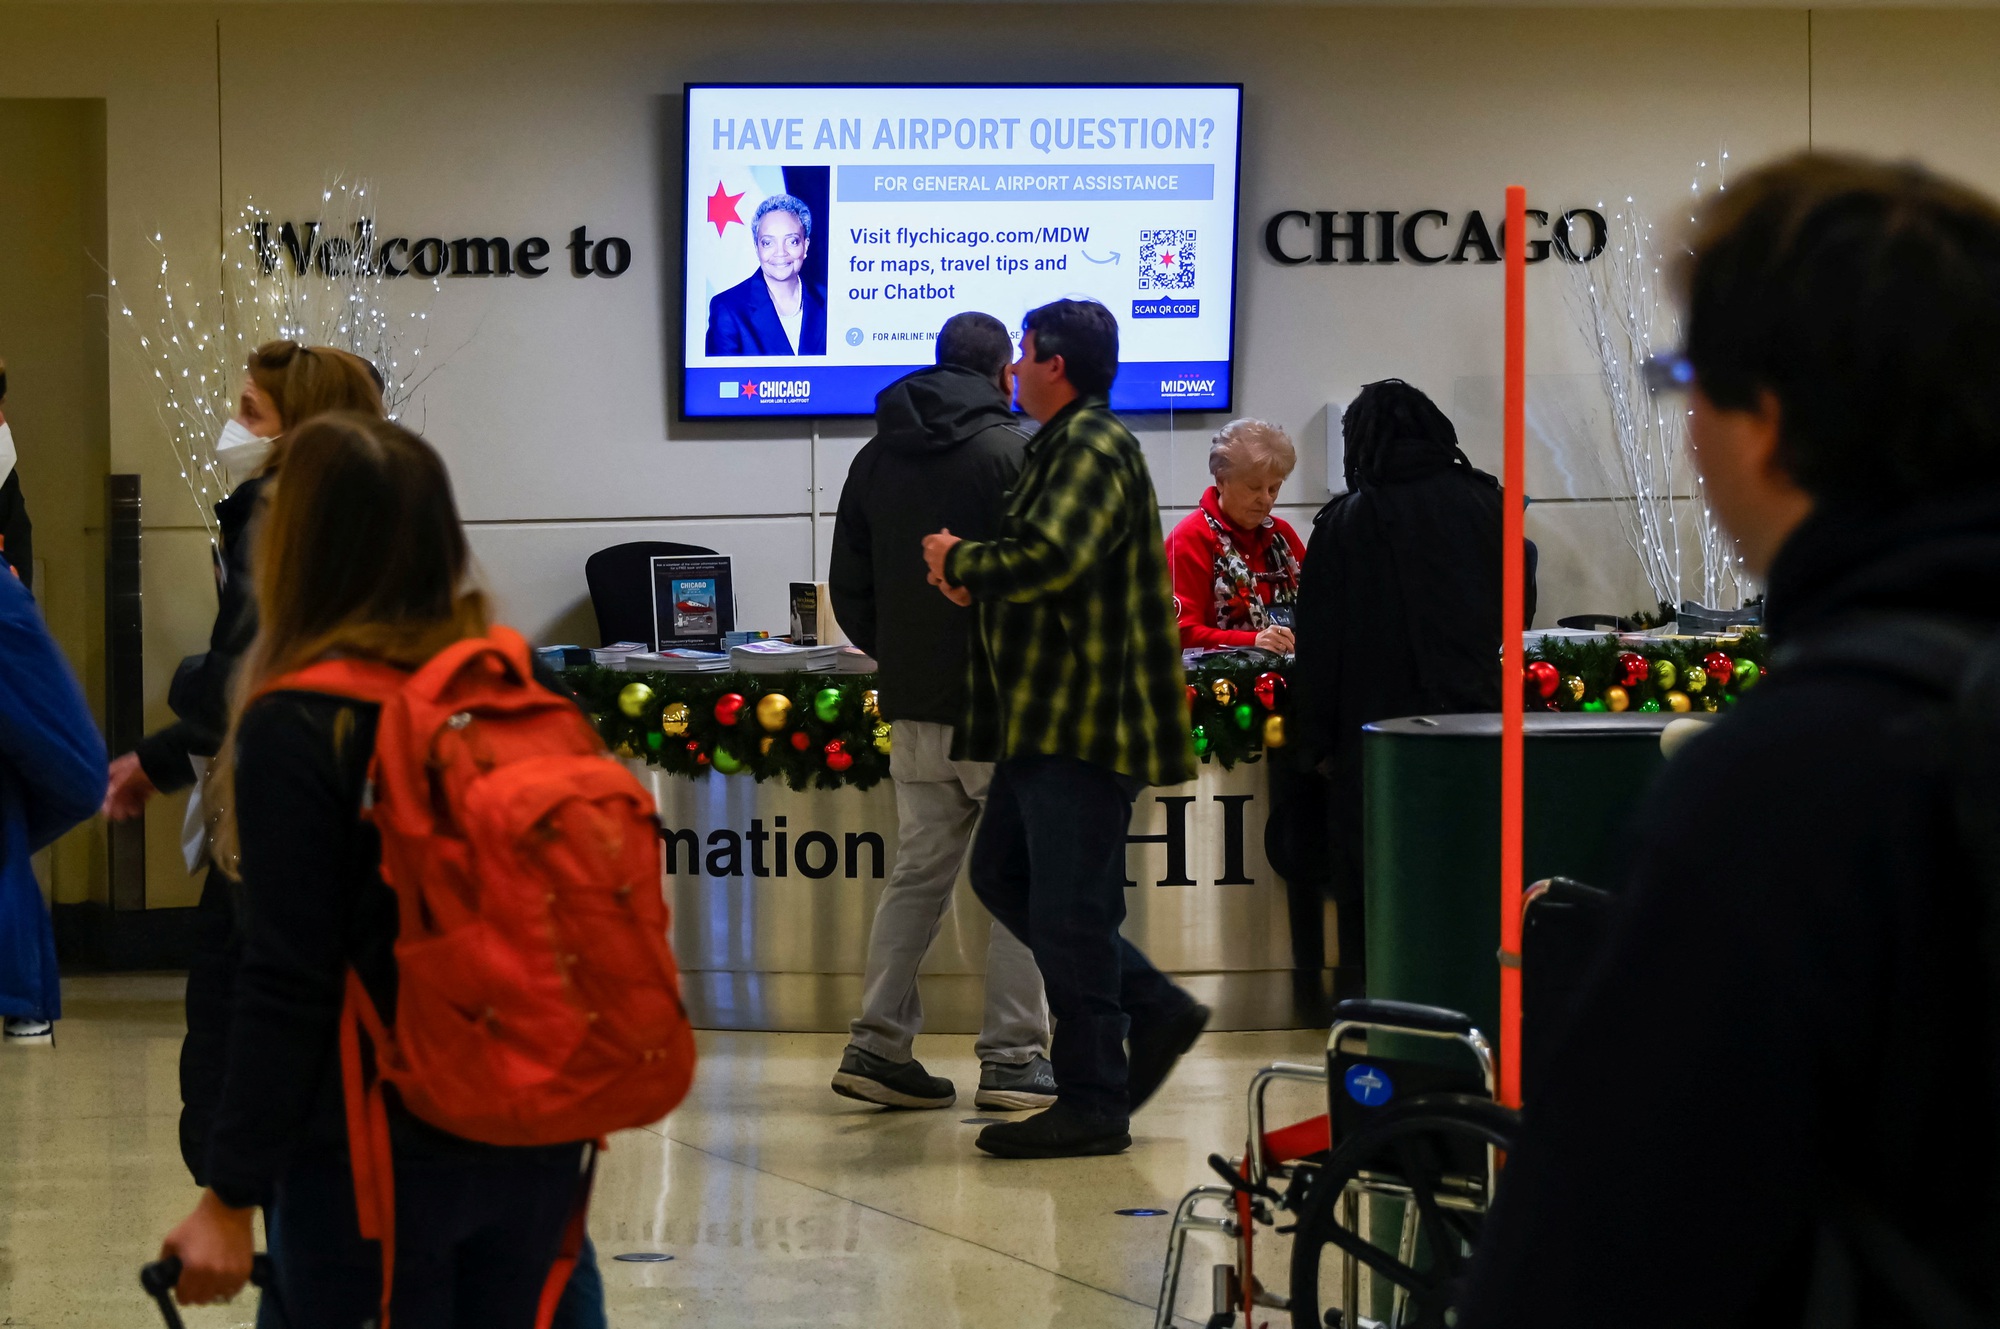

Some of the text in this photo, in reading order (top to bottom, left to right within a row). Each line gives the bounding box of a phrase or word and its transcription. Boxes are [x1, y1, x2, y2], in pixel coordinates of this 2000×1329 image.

[712, 117, 1215, 154] HAVE AN AIRPORT QUESTION?
[874, 175, 1179, 191] FOR GENERAL AIRPORT ASSISTANCE
[850, 227, 1090, 248] Visit flychicago.com/MDW
[1265, 208, 1608, 264] CHICAGO
[250, 218, 632, 276] Welcome to
[849, 254, 1067, 276] for maps, travel tips and
[848, 283, 956, 300] our Chatbot
[1134, 304, 1197, 315] SCAN QR CODE
[872, 332, 889, 341] FOR
[891, 332, 924, 341] AIRLINE
[759, 380, 811, 398] CHICAGO
[1161, 380, 1216, 393] MIDWAY
[680, 581, 707, 589] CHICAGO
